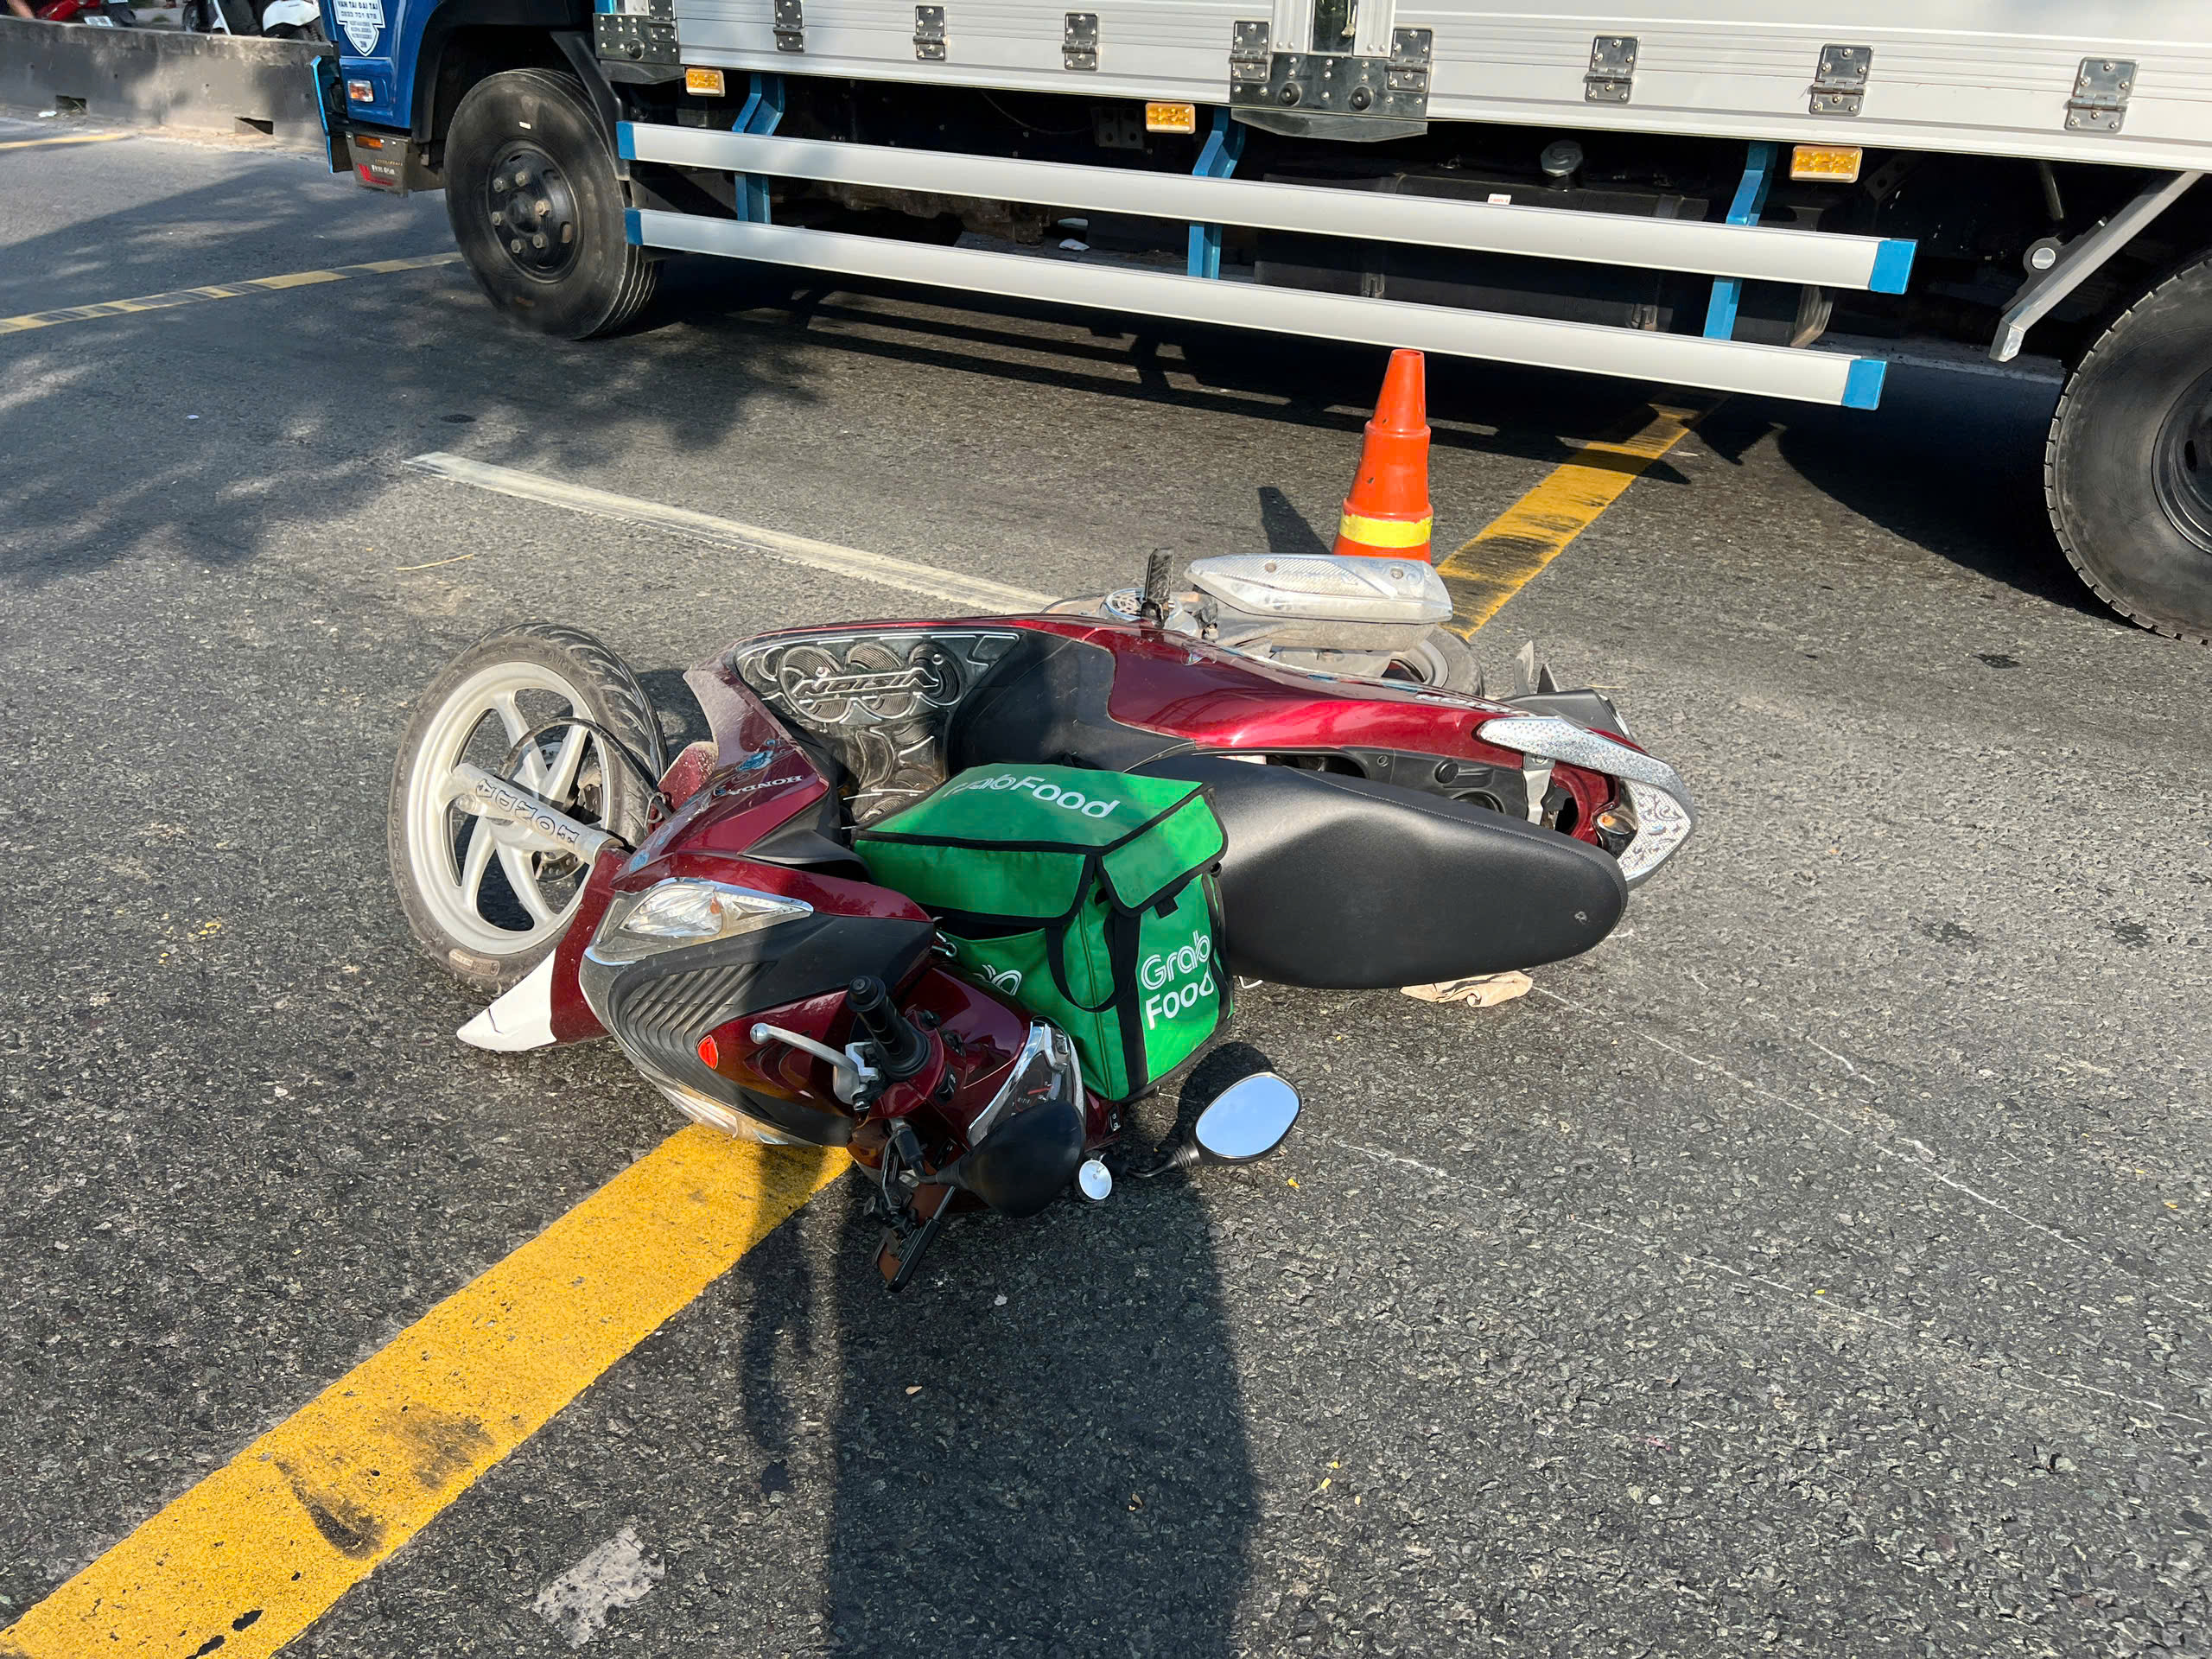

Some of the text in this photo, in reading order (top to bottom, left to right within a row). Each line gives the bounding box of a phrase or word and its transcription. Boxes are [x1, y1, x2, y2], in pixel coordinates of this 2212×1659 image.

[475, 778, 581, 845] HONDA
[728, 775, 803, 795] HONDA
[1141, 930, 1211, 990] Grab
